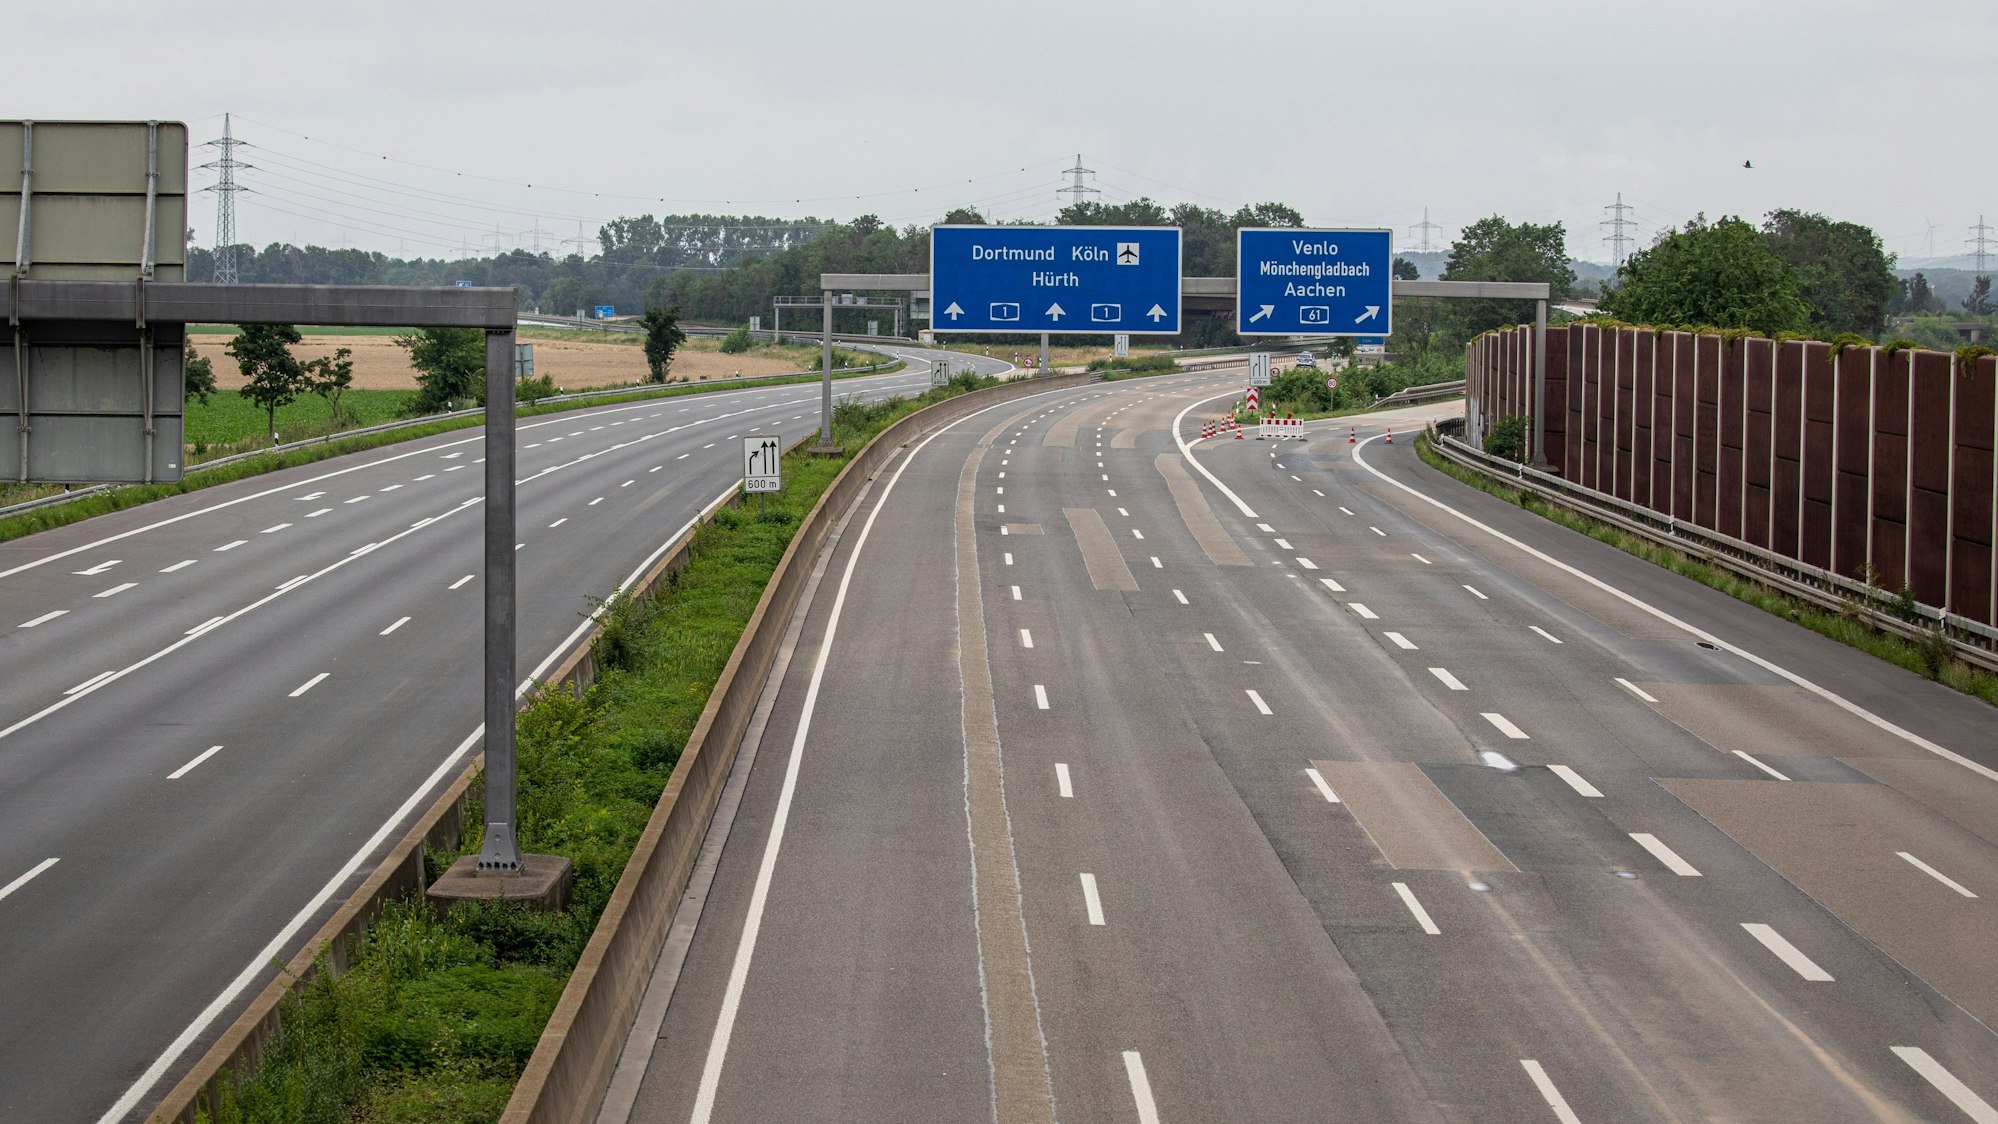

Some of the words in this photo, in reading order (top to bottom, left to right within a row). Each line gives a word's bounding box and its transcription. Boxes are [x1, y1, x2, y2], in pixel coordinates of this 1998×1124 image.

[972, 245, 1055, 261] Dortmund
[1072, 246, 1109, 261] Köln
[1292, 240, 1338, 255] Venlo
[1260, 261, 1370, 280] Mönchengladbach
[1032, 271, 1079, 287] Hürth
[1284, 282, 1346, 297] Aachen
[1002, 306, 1007, 318] 1
[1103, 307, 1109, 319] 1
[1308, 309, 1321, 321] 61
[748, 479, 766, 489] 600
